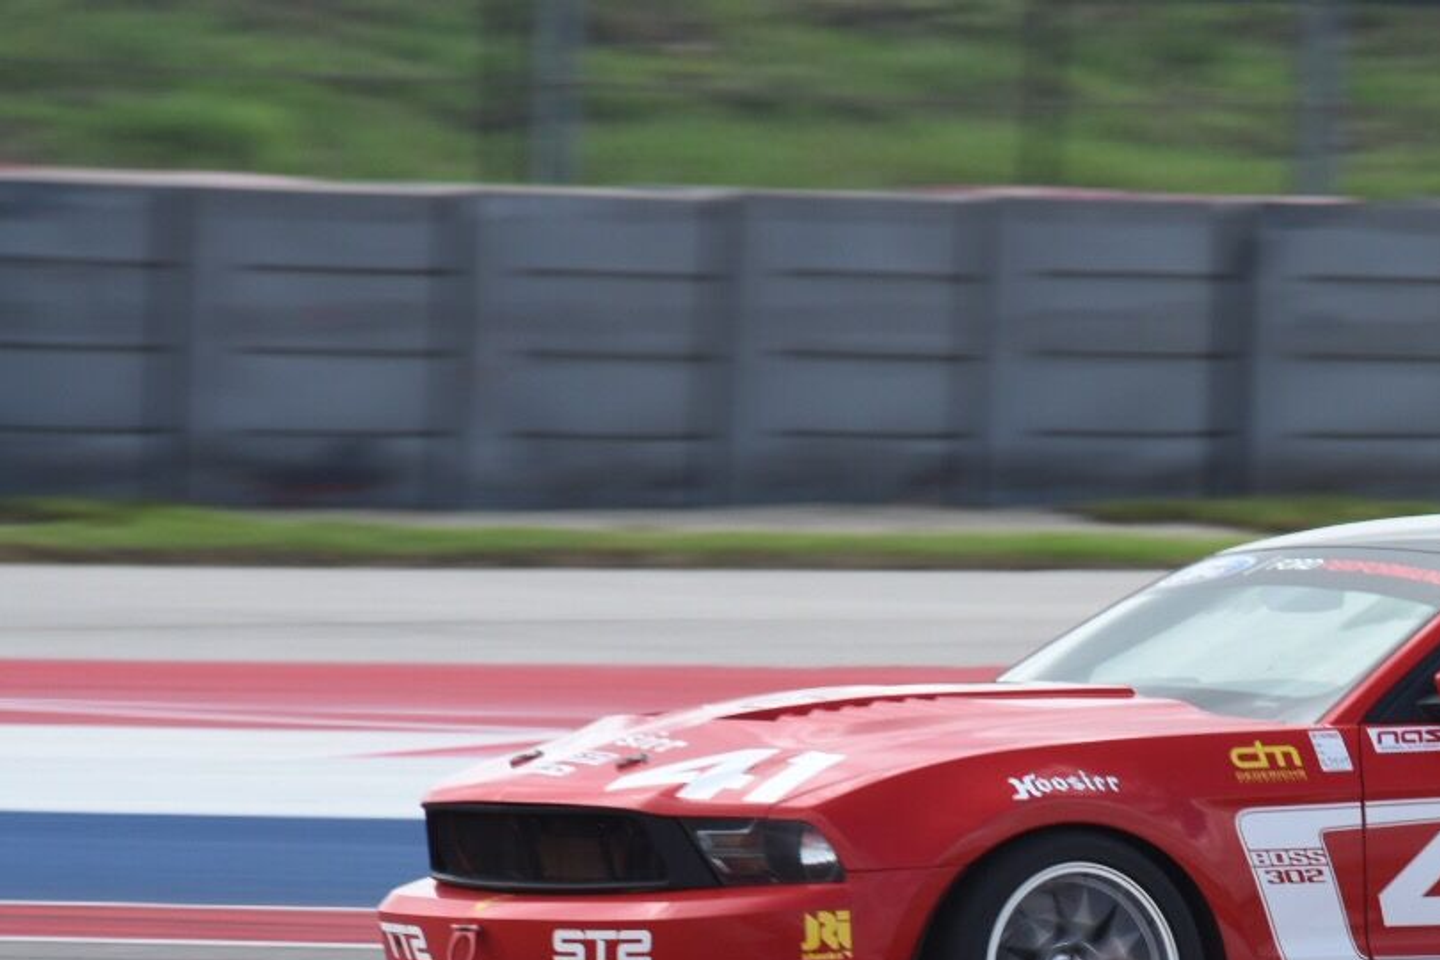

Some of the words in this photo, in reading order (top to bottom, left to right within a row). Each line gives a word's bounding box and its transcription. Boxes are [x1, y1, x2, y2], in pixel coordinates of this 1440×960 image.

[602, 746, 848, 801] 41
[1007, 770, 1121, 801] Hoosier
[1250, 848, 1330, 867] BOSS
[1264, 867, 1327, 886] 302
